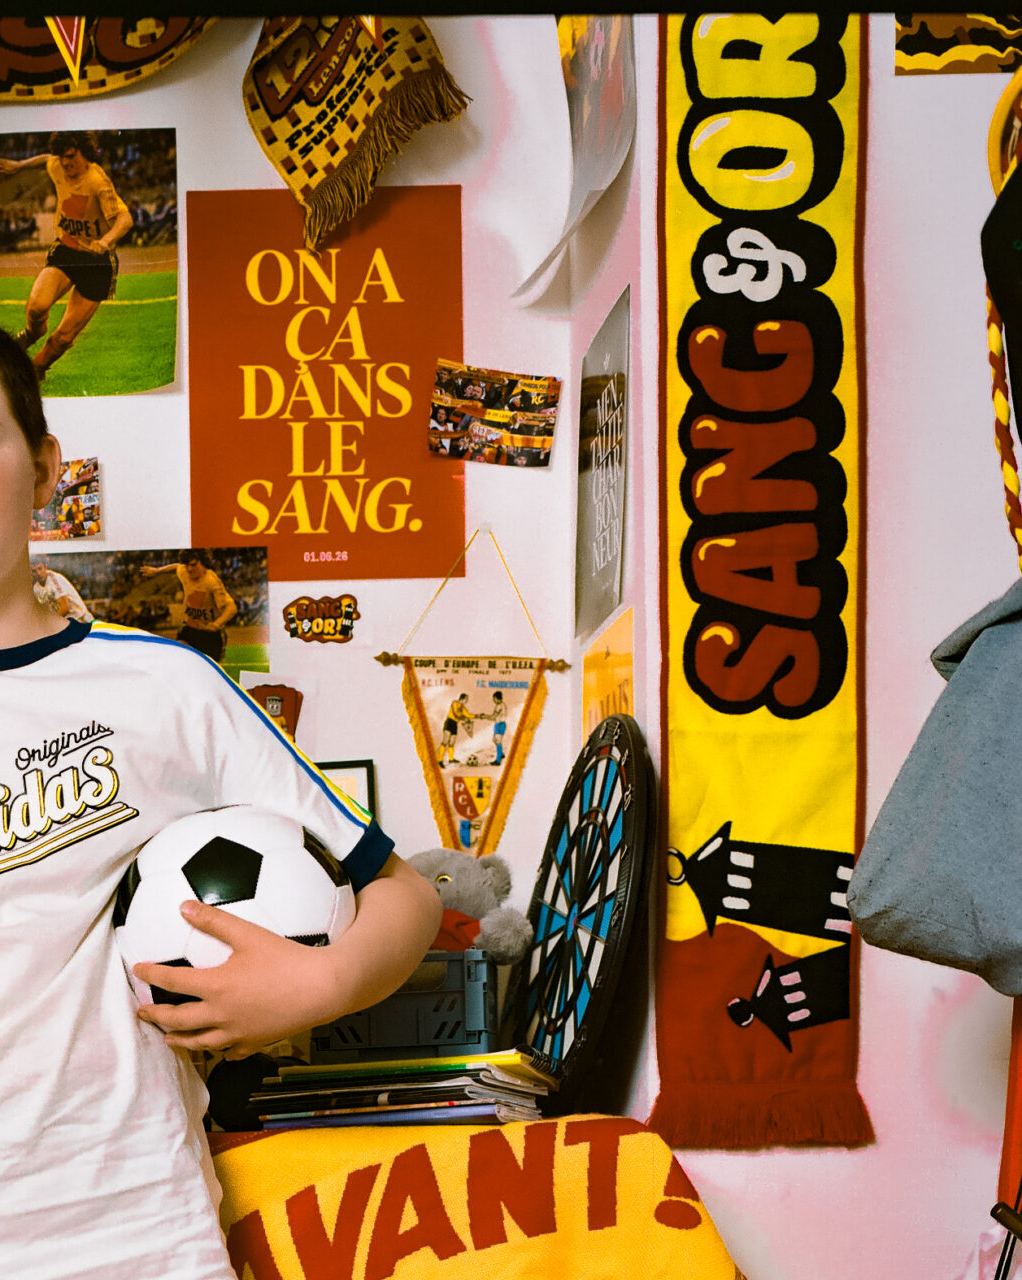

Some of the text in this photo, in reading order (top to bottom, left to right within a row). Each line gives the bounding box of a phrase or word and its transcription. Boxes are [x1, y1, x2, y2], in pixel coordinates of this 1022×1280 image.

[245, 248, 405, 305] ON A
[285, 306, 371, 374] ÇA
[683, 12, 828, 712] SANG & OR
[238, 363, 412, 420] DANS
[287, 421, 366, 477] LE
[232, 477, 423, 536] SANG.
[296, 601, 342, 620] SANG
[311, 618, 337, 636] OR
[414, 659, 436, 668] COUPE
[15, 720, 114, 770] Originals
